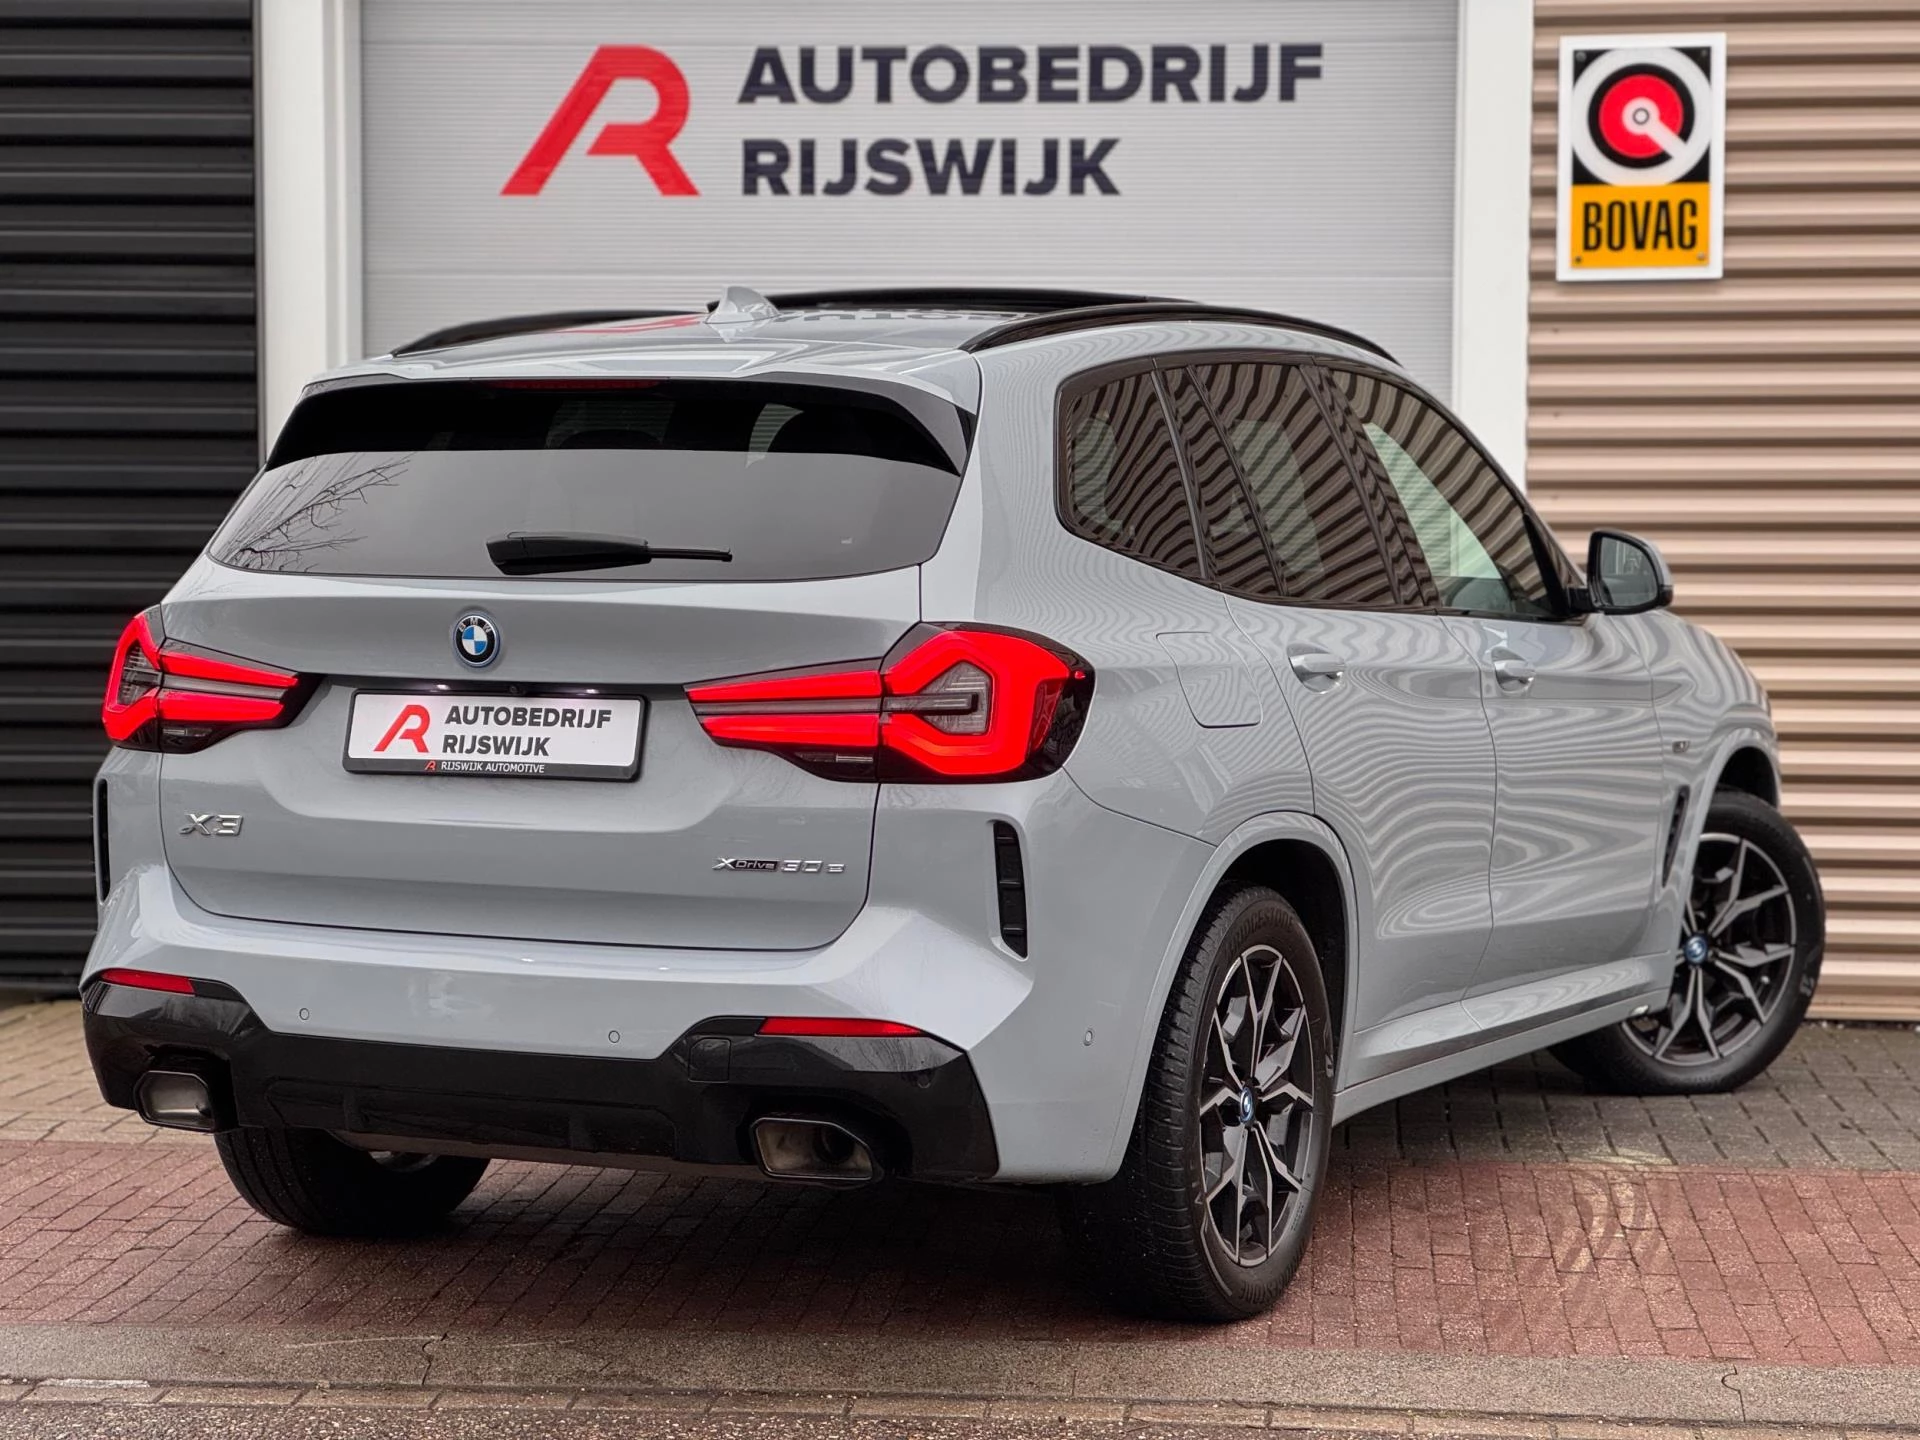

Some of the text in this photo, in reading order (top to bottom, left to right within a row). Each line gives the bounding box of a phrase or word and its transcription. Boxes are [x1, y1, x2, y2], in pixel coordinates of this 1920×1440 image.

[737, 43, 1324, 105] AUTOBEDRIJF
[742, 138, 1121, 196] RIJSWIJK
[1582, 199, 1698, 252] BOVAG
[459, 616, 492, 633] BMW
[445, 705, 612, 729] AUTOBEDRIJF
[442, 734, 551, 757] RIJSWIJK
[441, 761, 545, 774] RIJSWIJK AUTOMOTIVE
[180, 813, 244, 836] X3
